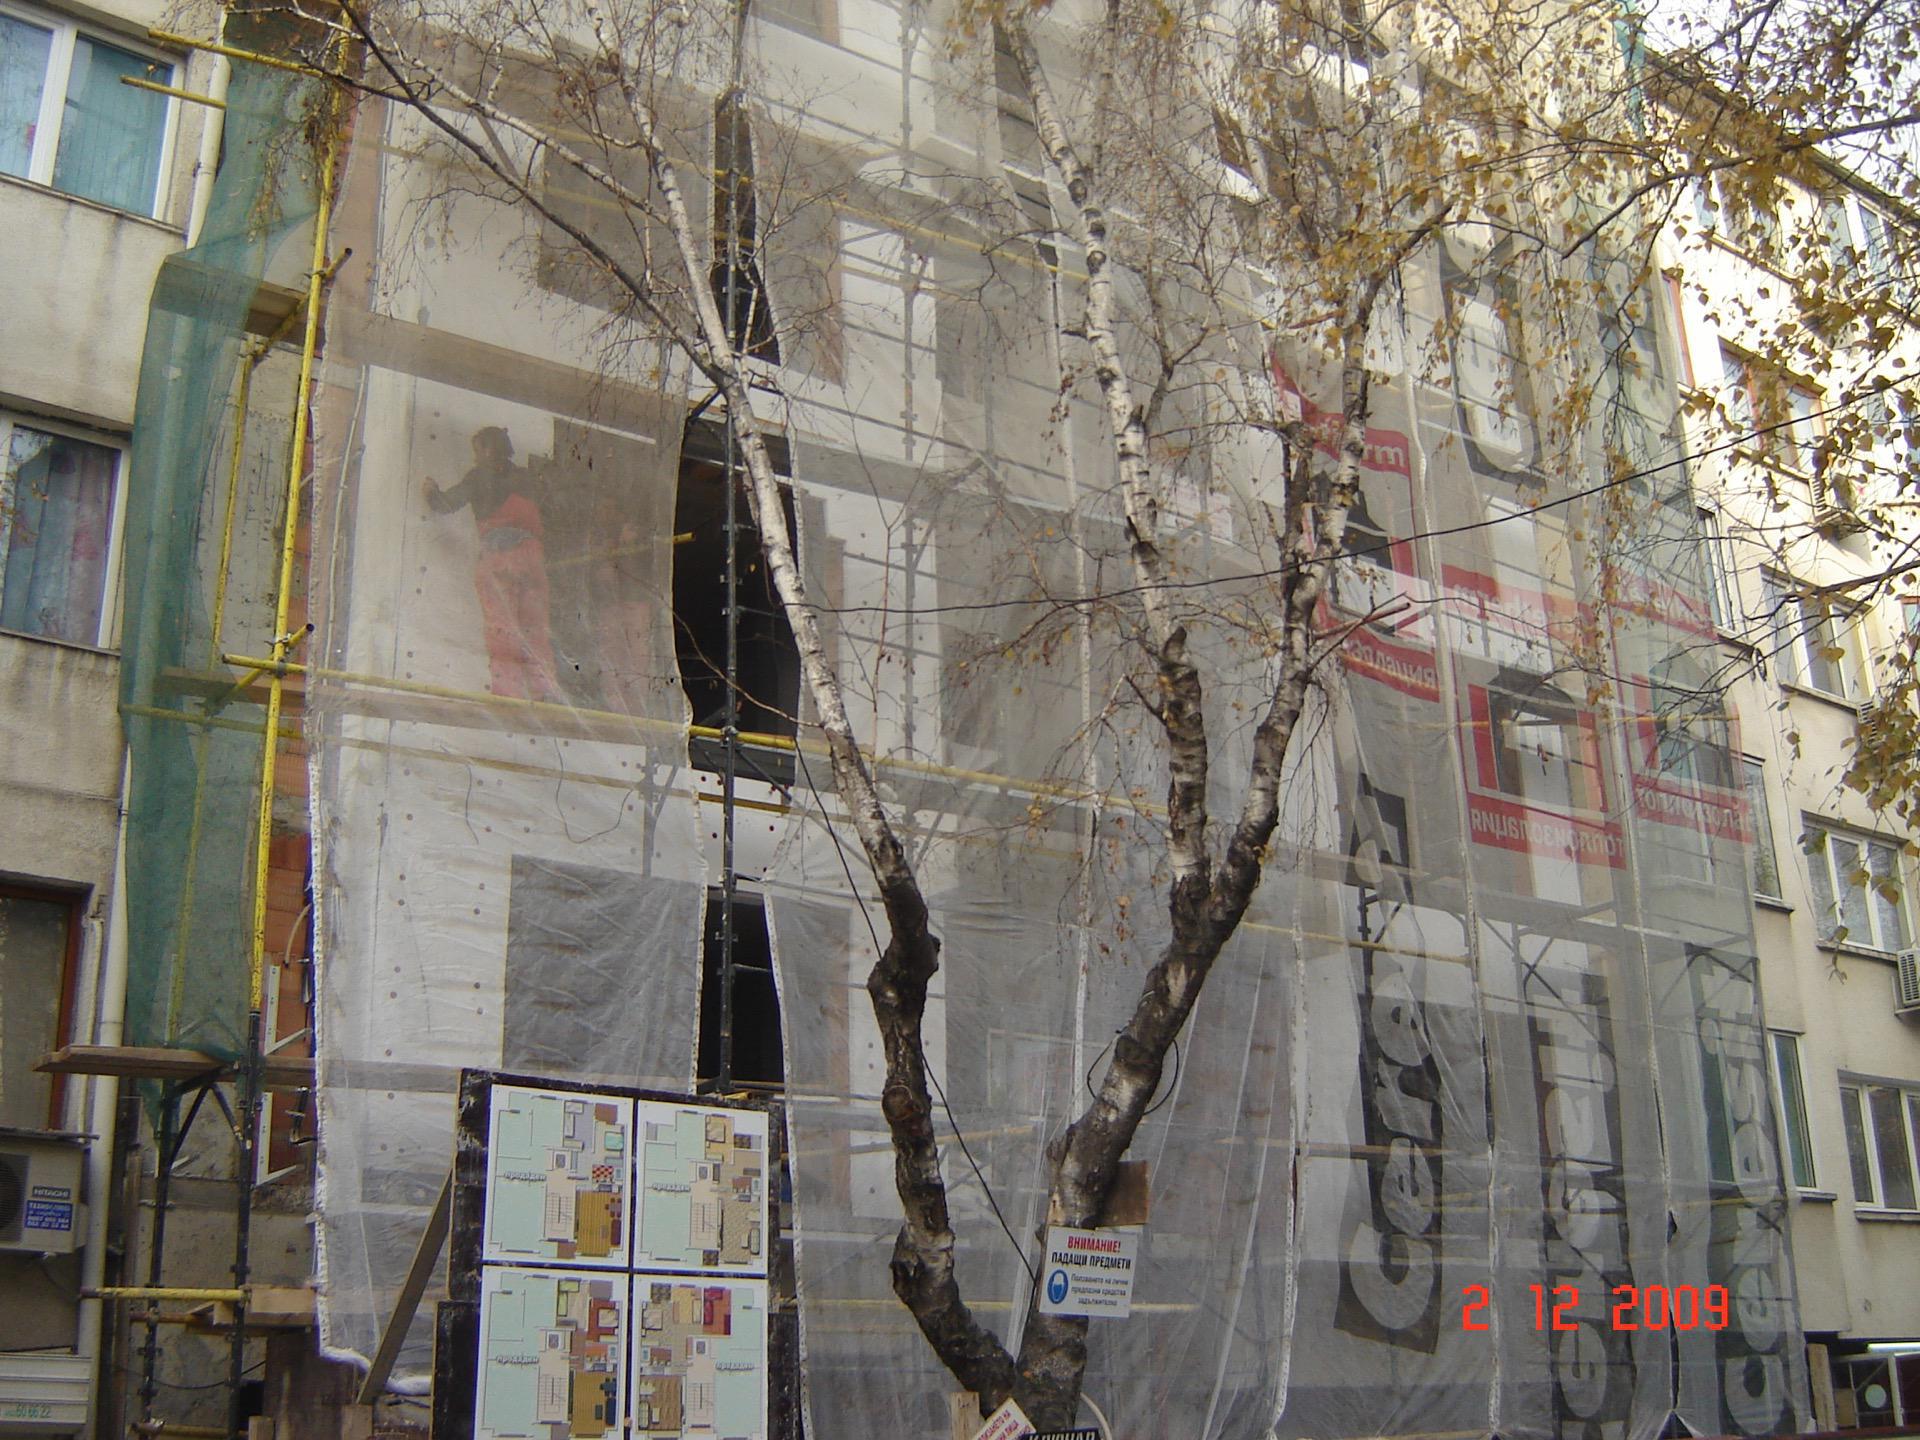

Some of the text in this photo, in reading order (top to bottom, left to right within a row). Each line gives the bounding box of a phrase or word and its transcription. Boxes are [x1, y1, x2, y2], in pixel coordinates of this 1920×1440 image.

[1067, 1235, 1121, 1253] ВНИМАНИЕ!
[1051, 1251, 1131, 1270] ПАДАЩИ ПРЕДМЕТИ
